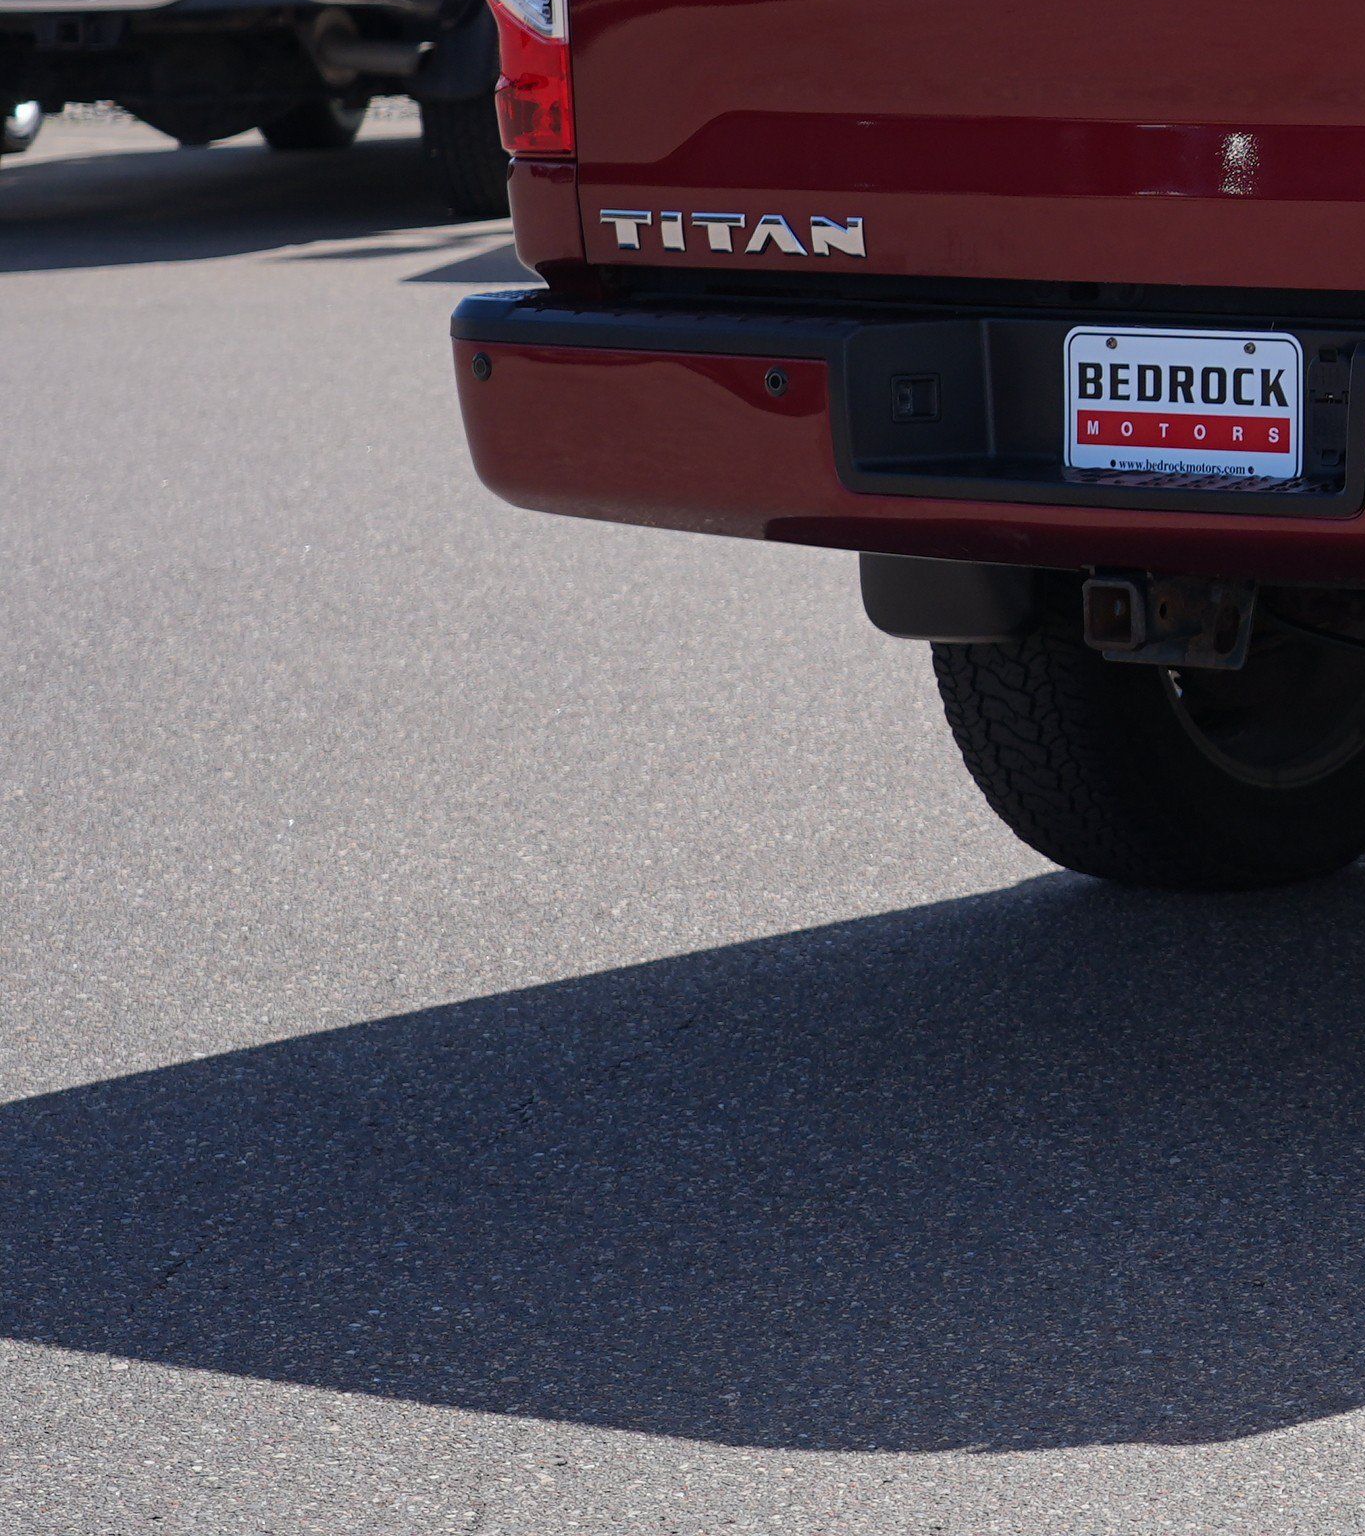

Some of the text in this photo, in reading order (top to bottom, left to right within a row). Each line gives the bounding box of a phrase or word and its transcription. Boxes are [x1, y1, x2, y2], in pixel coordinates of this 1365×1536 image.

[600, 209, 866, 257] TITAN
[1077, 362, 1290, 408] BEDROCK
[1086, 419, 1280, 444] MOTORS
[1118, 458, 1246, 475] www.bedrockmotors.com
